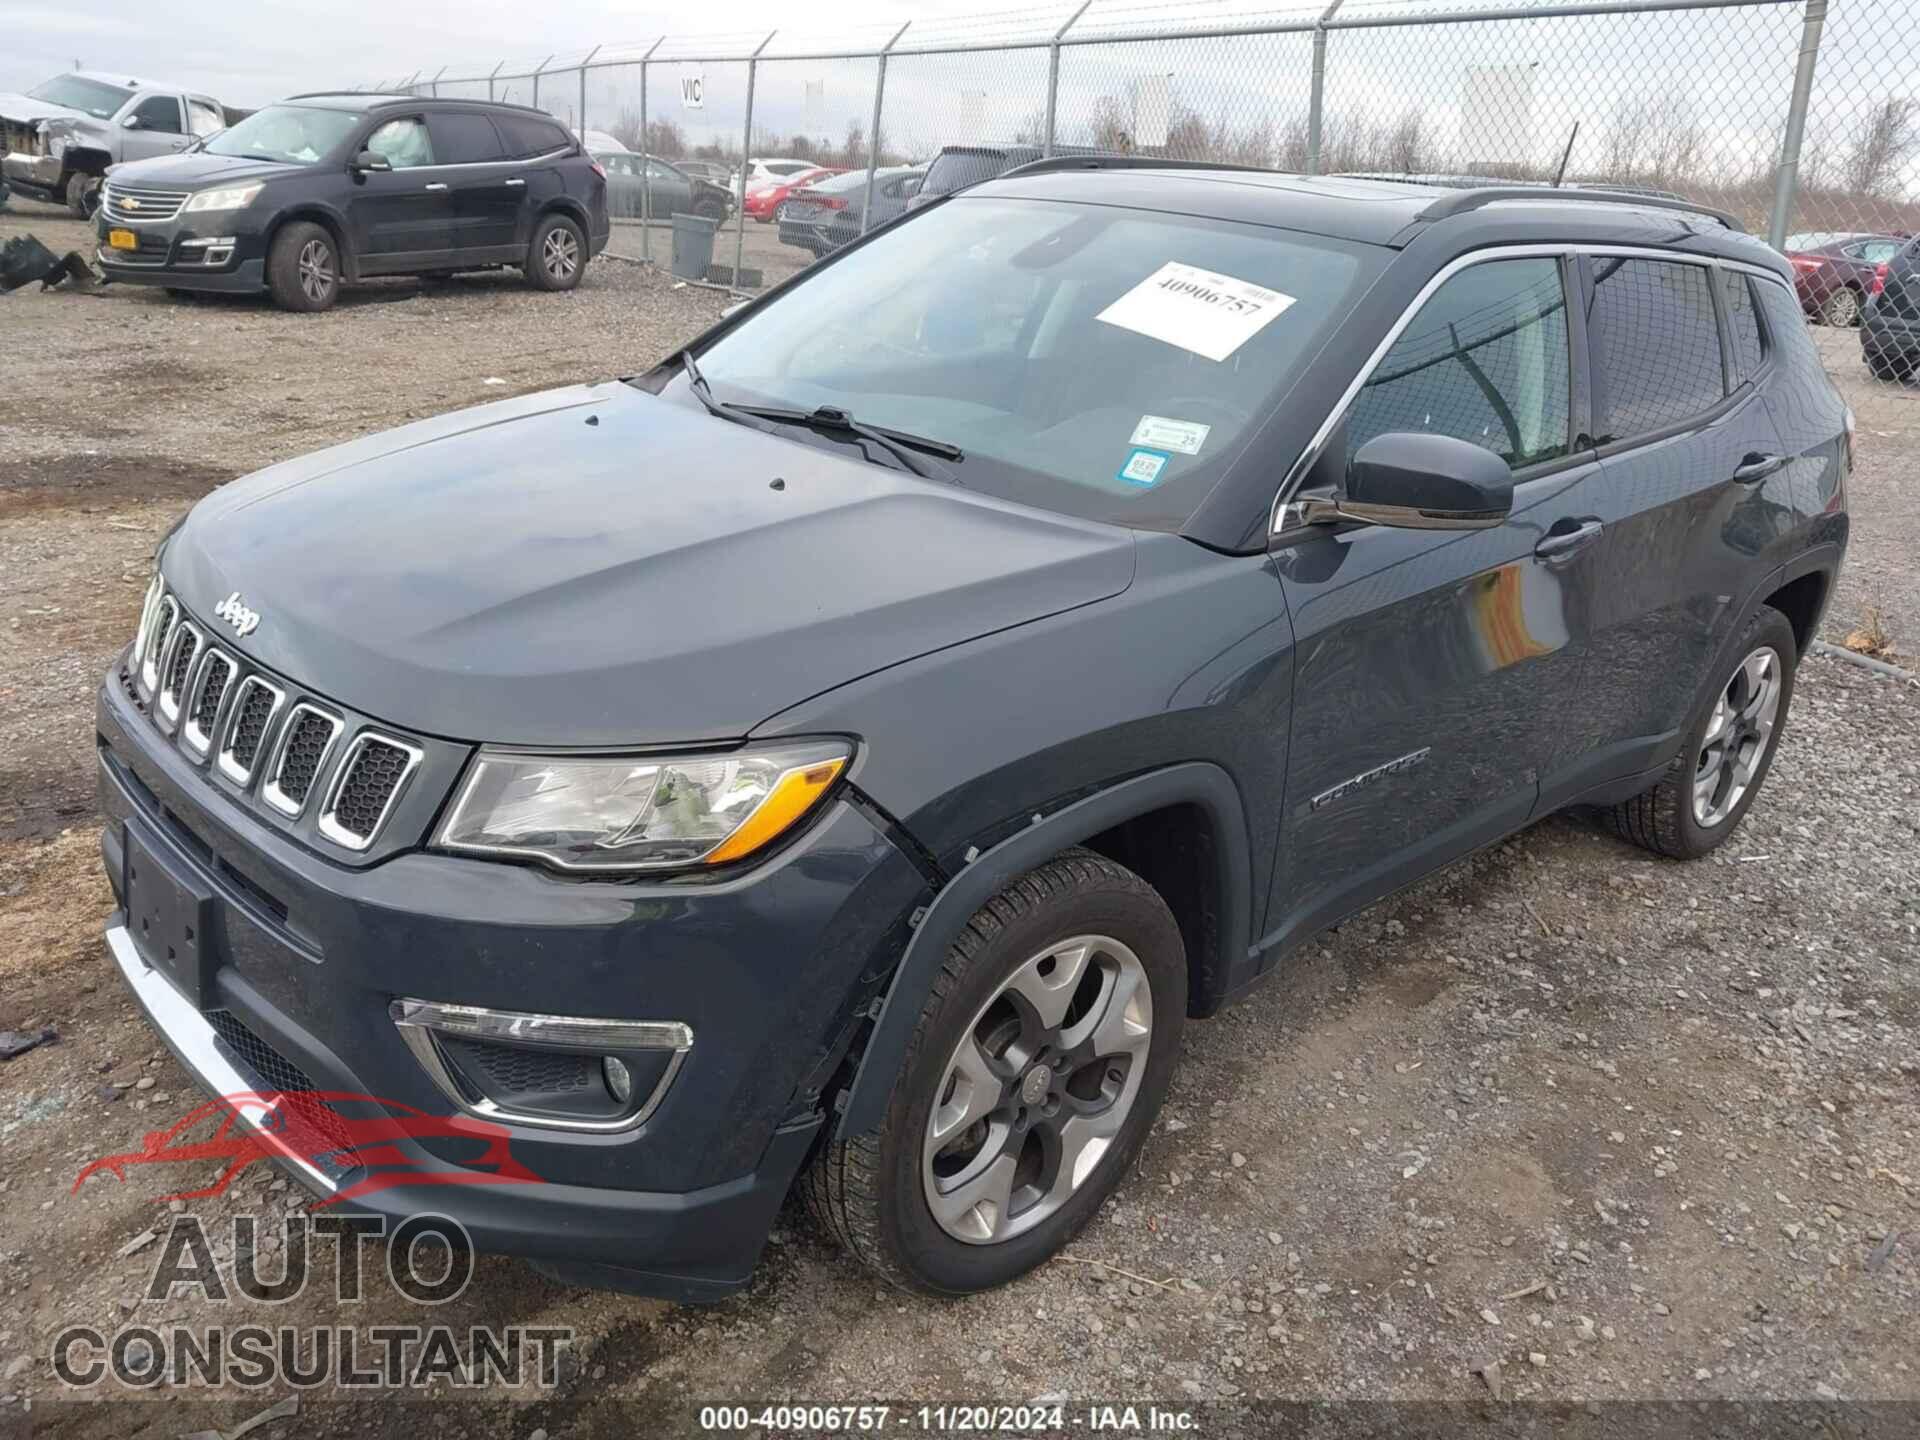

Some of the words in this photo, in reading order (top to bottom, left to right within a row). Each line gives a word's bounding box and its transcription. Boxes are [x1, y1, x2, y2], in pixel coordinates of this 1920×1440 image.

[681, 78, 702, 102] VIC
[1157, 278, 1262, 316] 40906757
[1181, 434, 1197, 446] 25
[215, 592, 260, 637] Jeep
